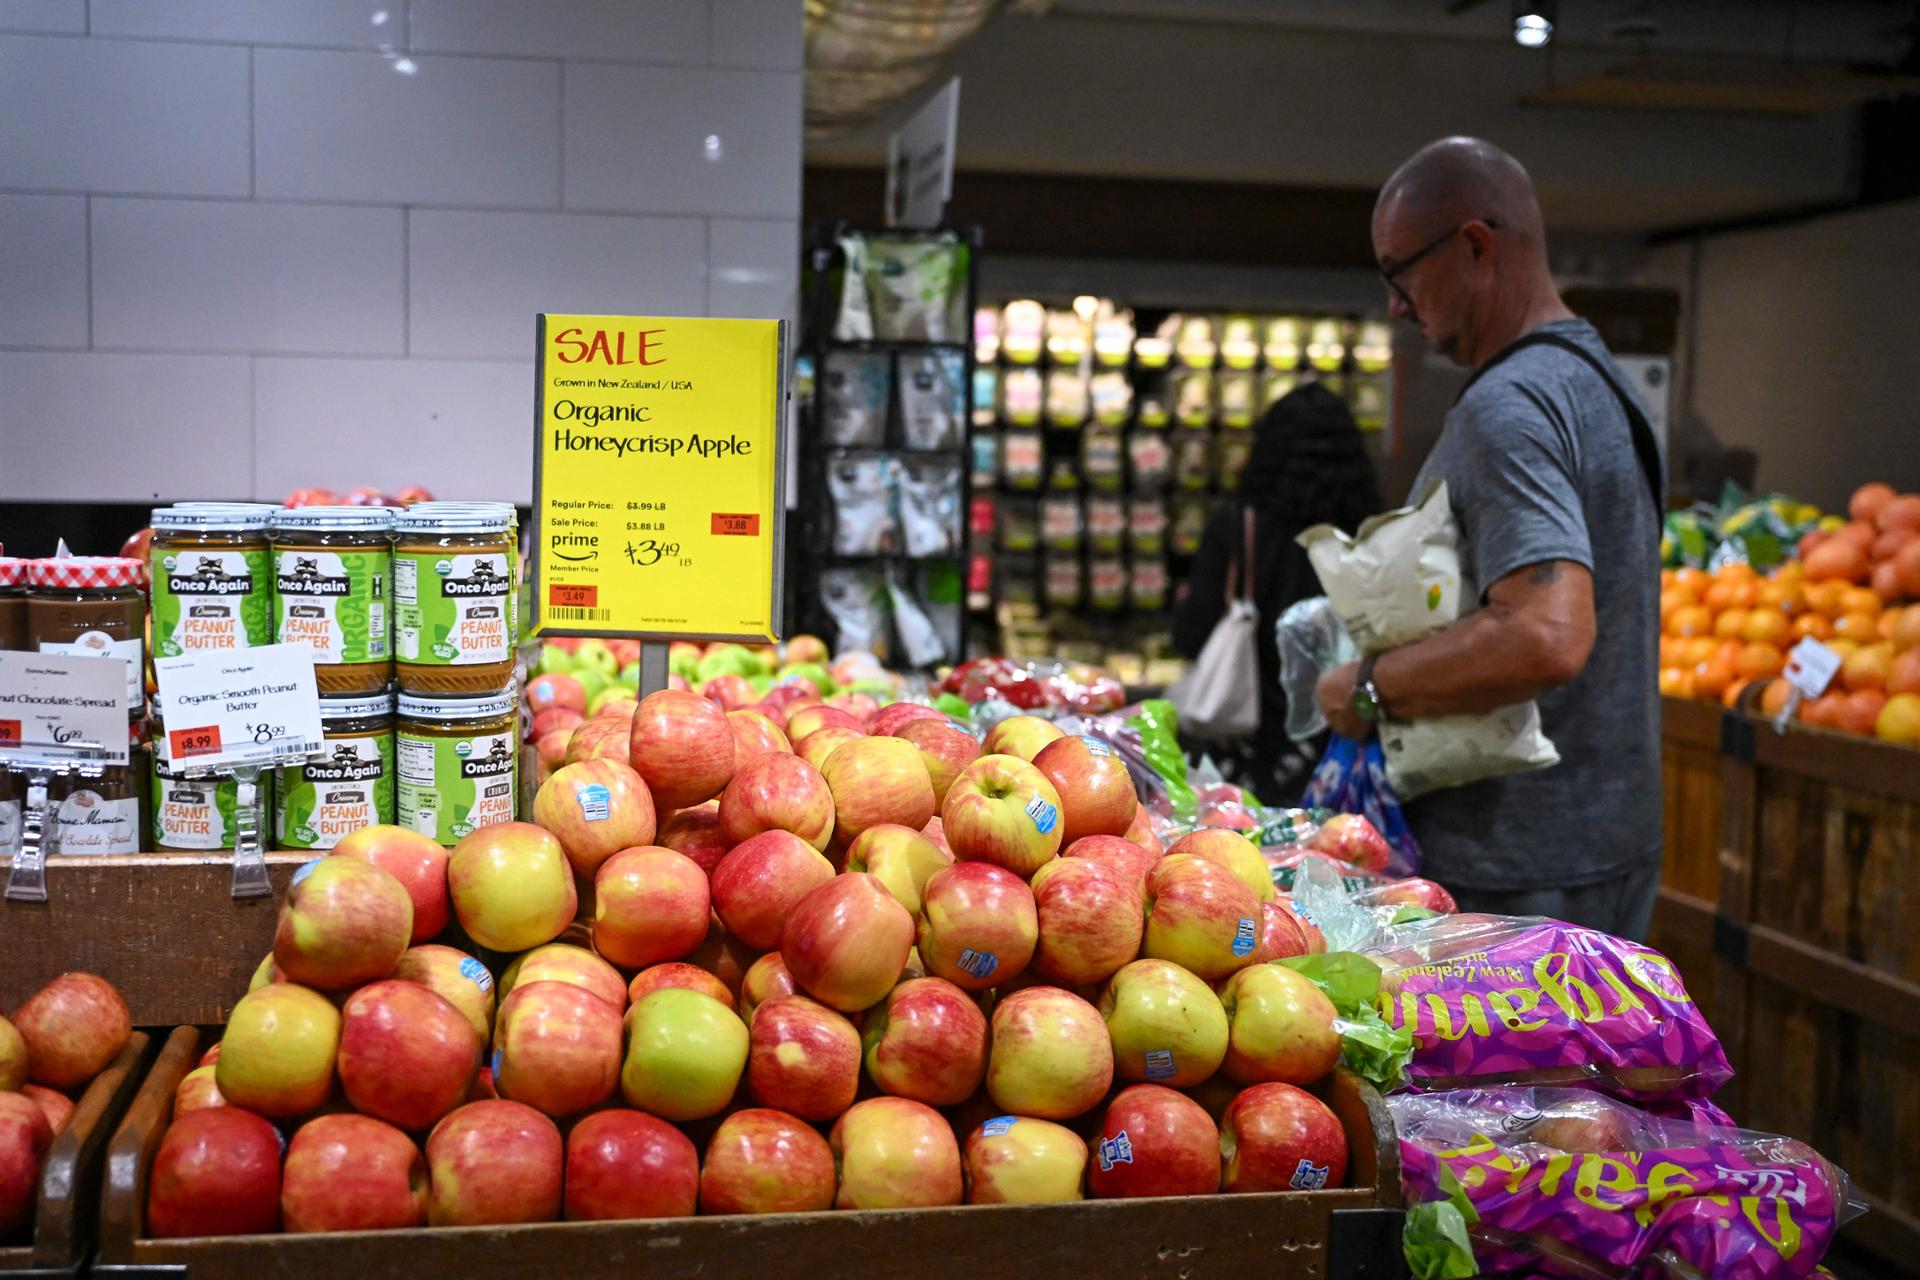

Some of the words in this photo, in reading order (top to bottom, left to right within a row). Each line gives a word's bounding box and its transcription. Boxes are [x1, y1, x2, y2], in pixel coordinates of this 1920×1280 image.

[554, 328, 667, 366] SALE
[554, 377, 586, 389] Grown
[587, 379, 596, 388] in
[598, 379, 619, 389] New
[620, 379, 660, 390] Zealand
[661, 380, 670, 391] /
[671, 381, 693, 391] USA
[554, 400, 652, 427] Organic
[555, 429, 684, 458] Honeycrisp
[687, 434, 752, 458] Apple
[552, 500, 586, 510] Regular
[588, 501, 614, 510] Price:
[626, 502, 652, 511] $3.99
[654, 502, 666, 511] LB
[551, 518, 570, 527] Sale
[572, 519, 598, 528] Price:
[626, 522, 652, 531] $3.88
[653, 522, 665, 531] LB
[552, 532, 599, 548] prime
[550, 564, 579, 572] Member
[679, 558, 692, 567] LB
[170, 578, 207, 591] Once
[207, 580, 250, 594] Again
[278, 579, 303, 591] Once
[303, 580, 347, 594] Again
[445, 582, 481, 593] Once
[482, 580, 508, 595] Again
[184, 619, 236, 633] PEANUT
[286, 619, 330, 633] PEANUT
[461, 619, 502, 634] PEANUT
[185, 635, 236, 649] BUTTER
[461, 636, 502, 649] BUTTER
[17, 694, 73, 706] Chocolate
[74, 697, 116, 708] Spread
[178, 693, 221, 706] Organic
[221, 687, 261, 700] Smooth
[262, 682, 298, 695] Peanut
[226, 701, 258, 712] Butter
[181, 735, 211, 749] $8.99
[306, 766, 343, 778] Once
[343, 764, 381, 779] Again
[465, 763, 497, 774] Once
[165, 804, 210, 819] PEANUT
[320, 803, 369, 819] PEANUT
[480, 796, 512, 813] PEANUT
[81, 809, 126, 825] Maman
[165, 819, 210, 834] BUTTER
[321, 819, 369, 834] BUTTER
[1400, 964, 1479, 984] Zealand
[1480, 965, 1524, 983] New
